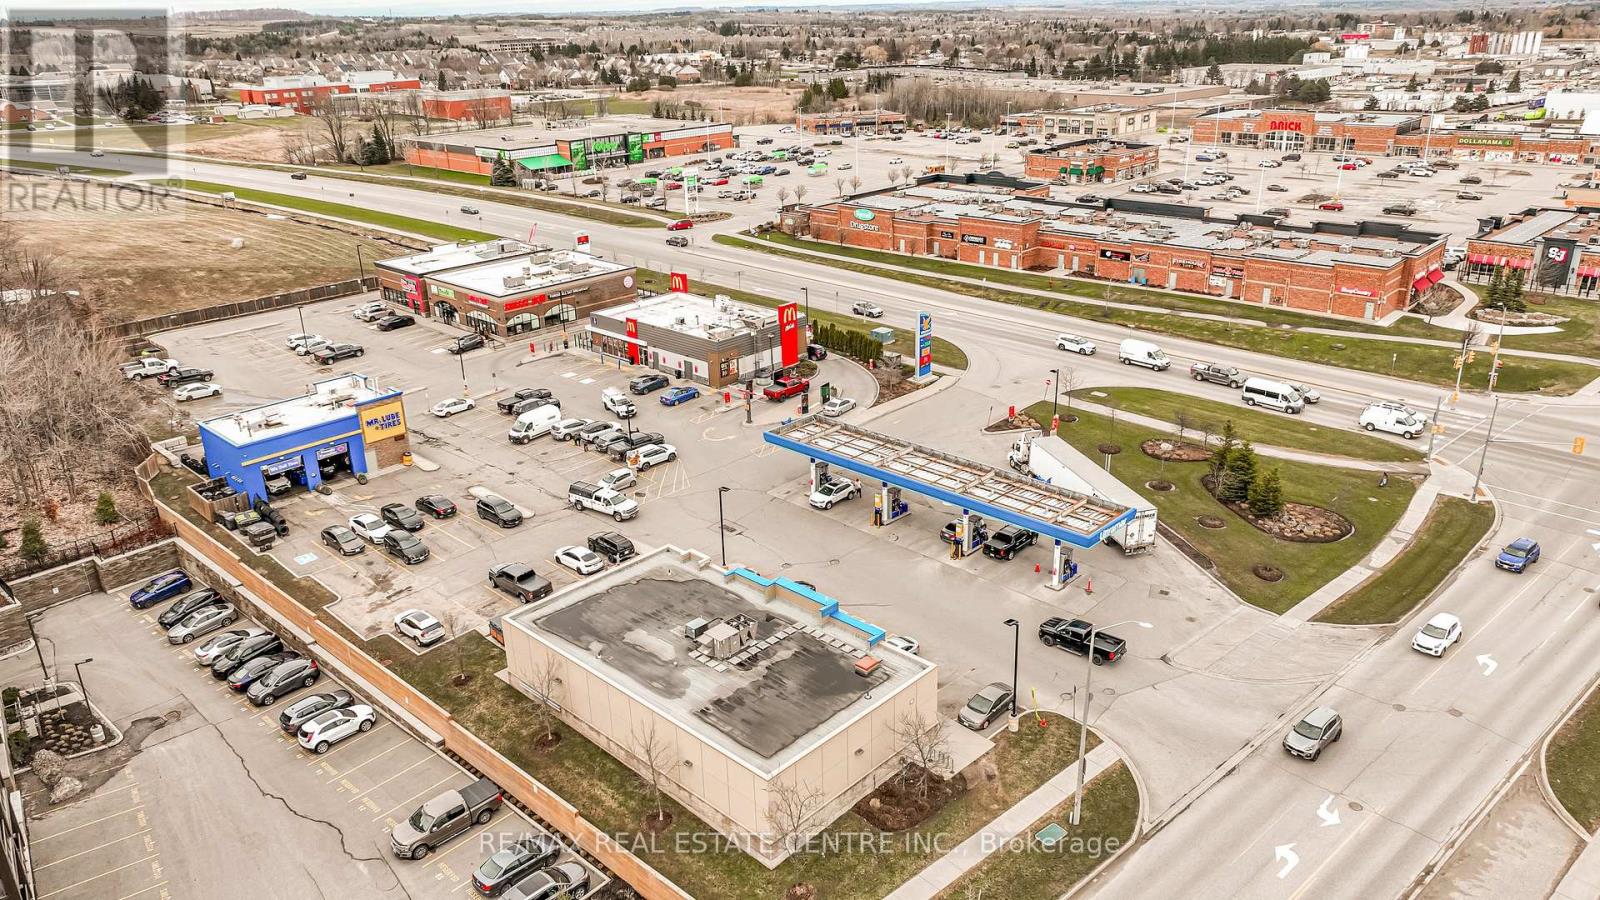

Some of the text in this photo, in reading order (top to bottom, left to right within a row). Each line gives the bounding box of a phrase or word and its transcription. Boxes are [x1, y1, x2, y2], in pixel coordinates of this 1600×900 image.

[1270, 120, 1302, 131] BRICK
[1458, 138, 1503, 146] DOLLARAMA
[381, 412, 401, 422] LUBE
[379, 418, 402, 430] TIRES
